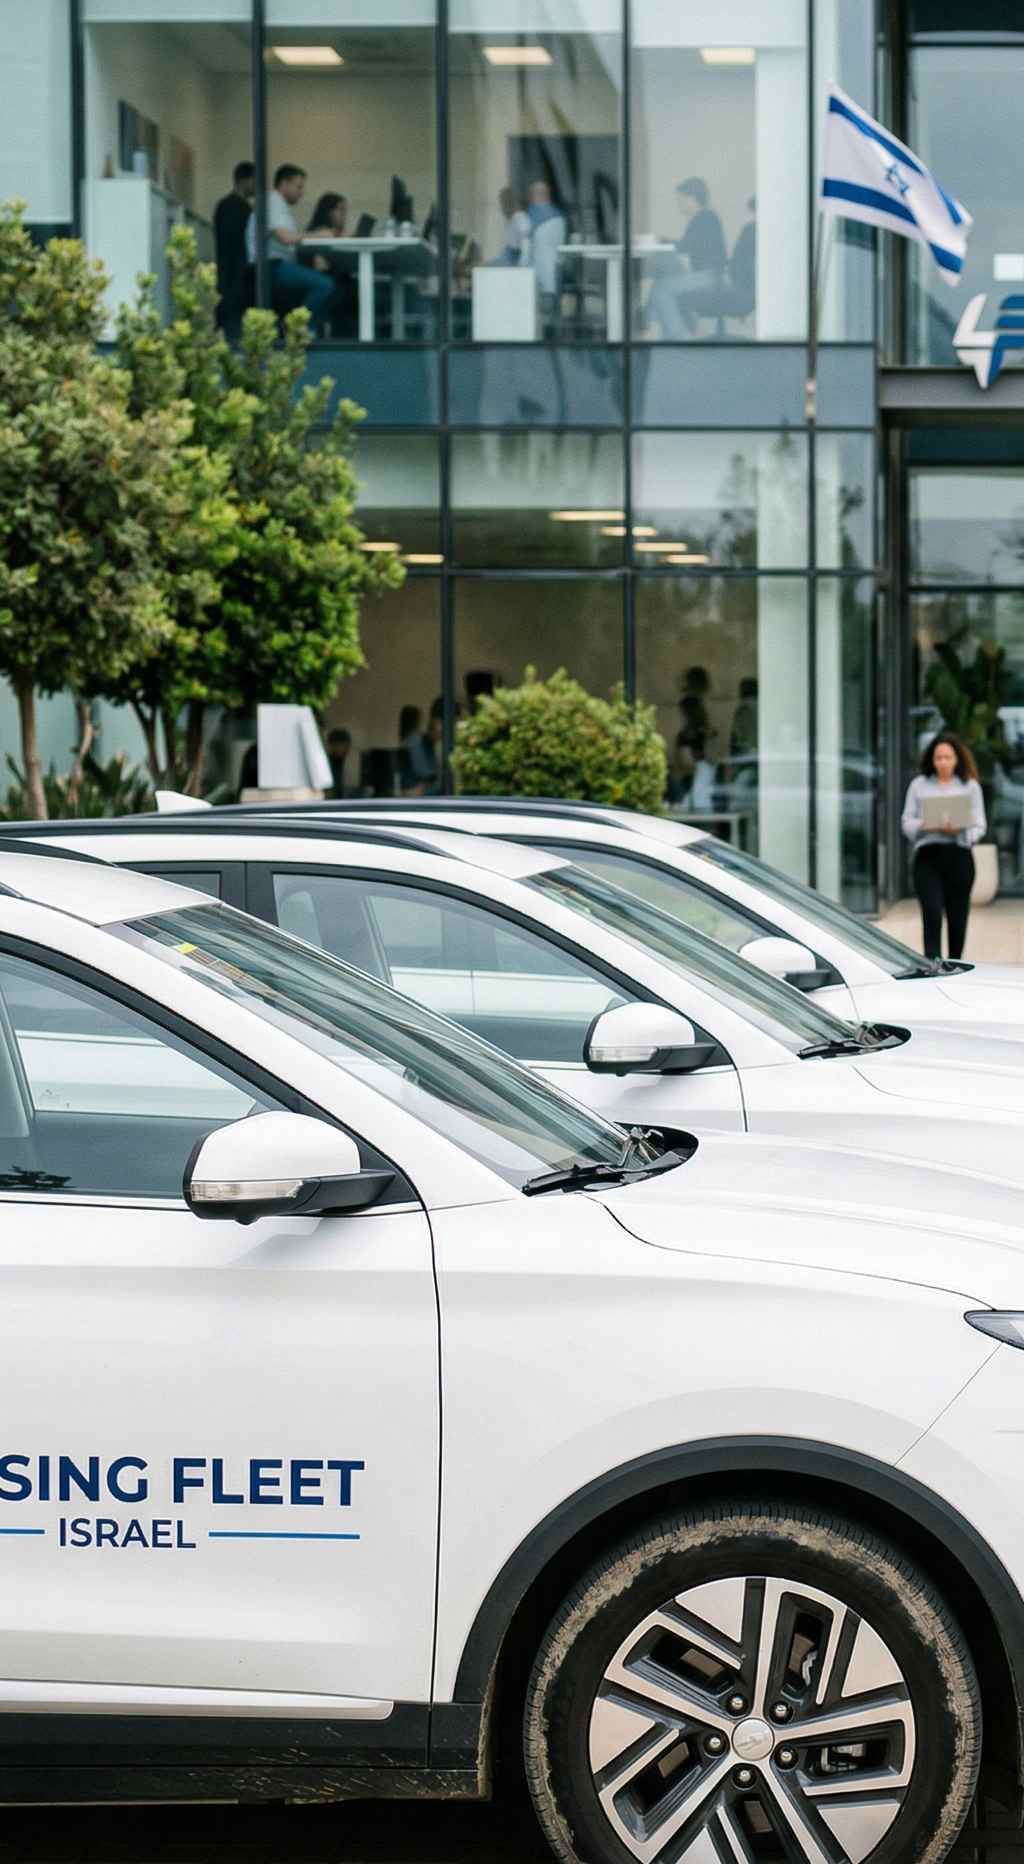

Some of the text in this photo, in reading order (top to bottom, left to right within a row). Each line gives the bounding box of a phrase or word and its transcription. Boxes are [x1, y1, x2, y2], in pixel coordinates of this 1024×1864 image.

[0, 1454, 366, 1507] SING FLEET
[58, 1517, 197, 1549] ISRAEL
